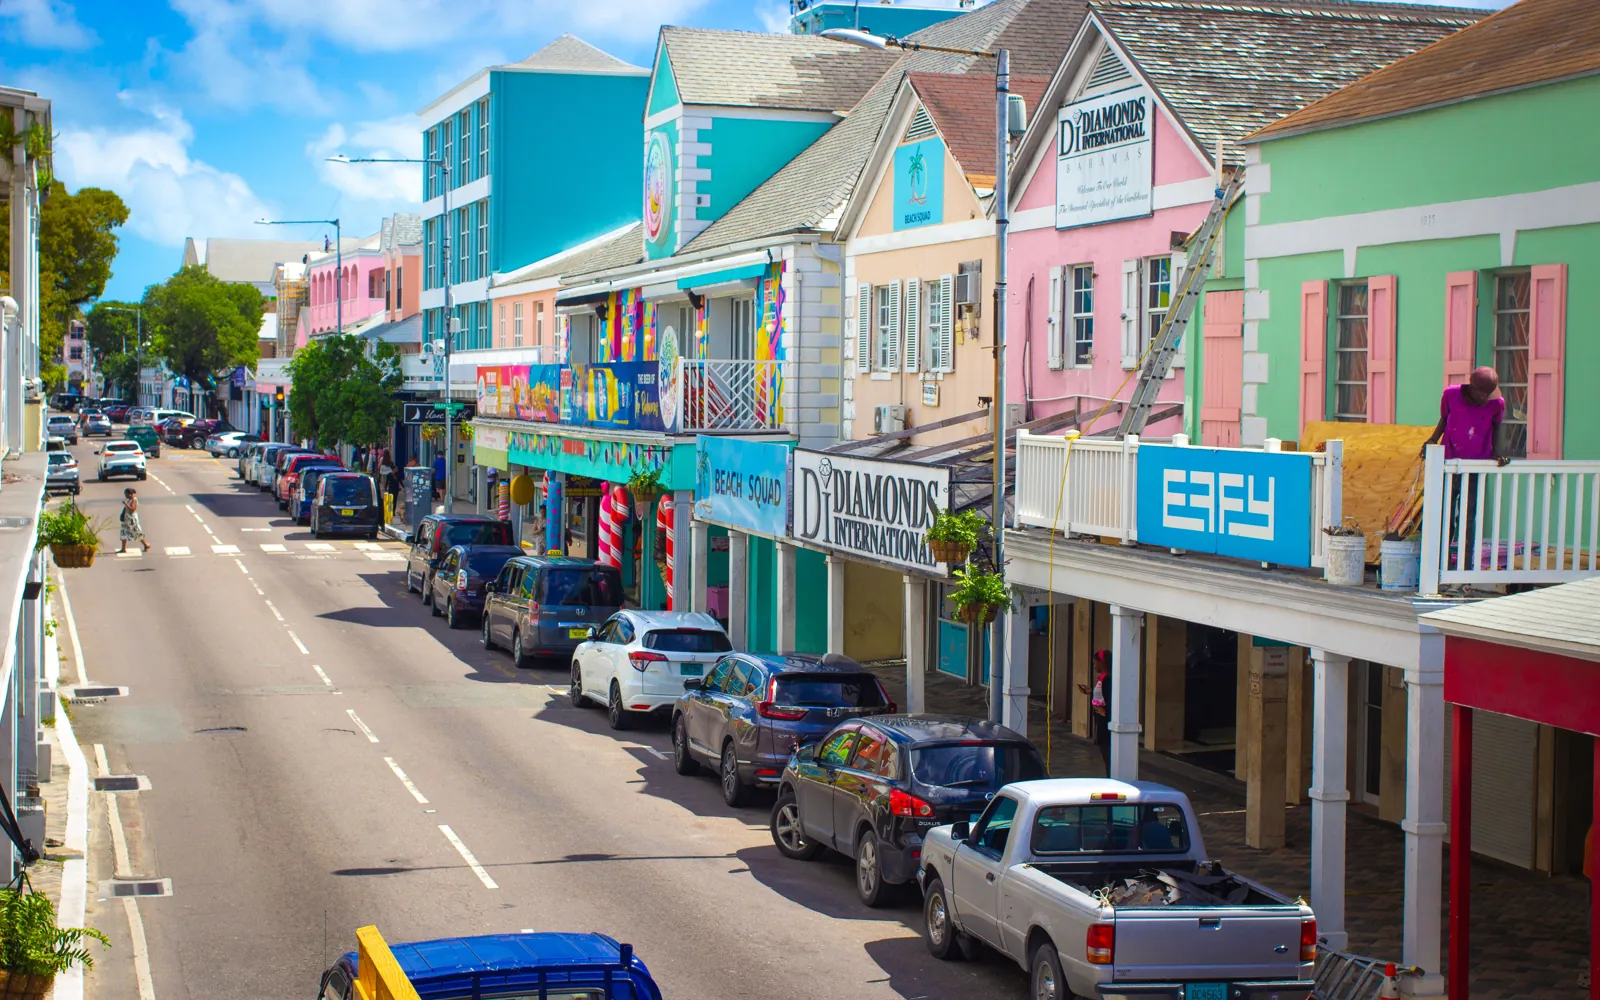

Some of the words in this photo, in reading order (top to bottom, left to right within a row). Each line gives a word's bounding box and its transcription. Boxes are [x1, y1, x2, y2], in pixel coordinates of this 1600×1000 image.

[1082, 96, 1146, 134] DIAMONDS
[1082, 122, 1145, 150] INTERNATIONAL
[1066, 148, 1142, 174] BAHAMAS
[904, 213, 917, 224] BEACH
[917, 210, 931, 223] SQUAD
[714, 468, 742, 498] BEACH
[748, 474, 782, 508] SQUAD
[832, 467, 938, 530] DIAMONDS
